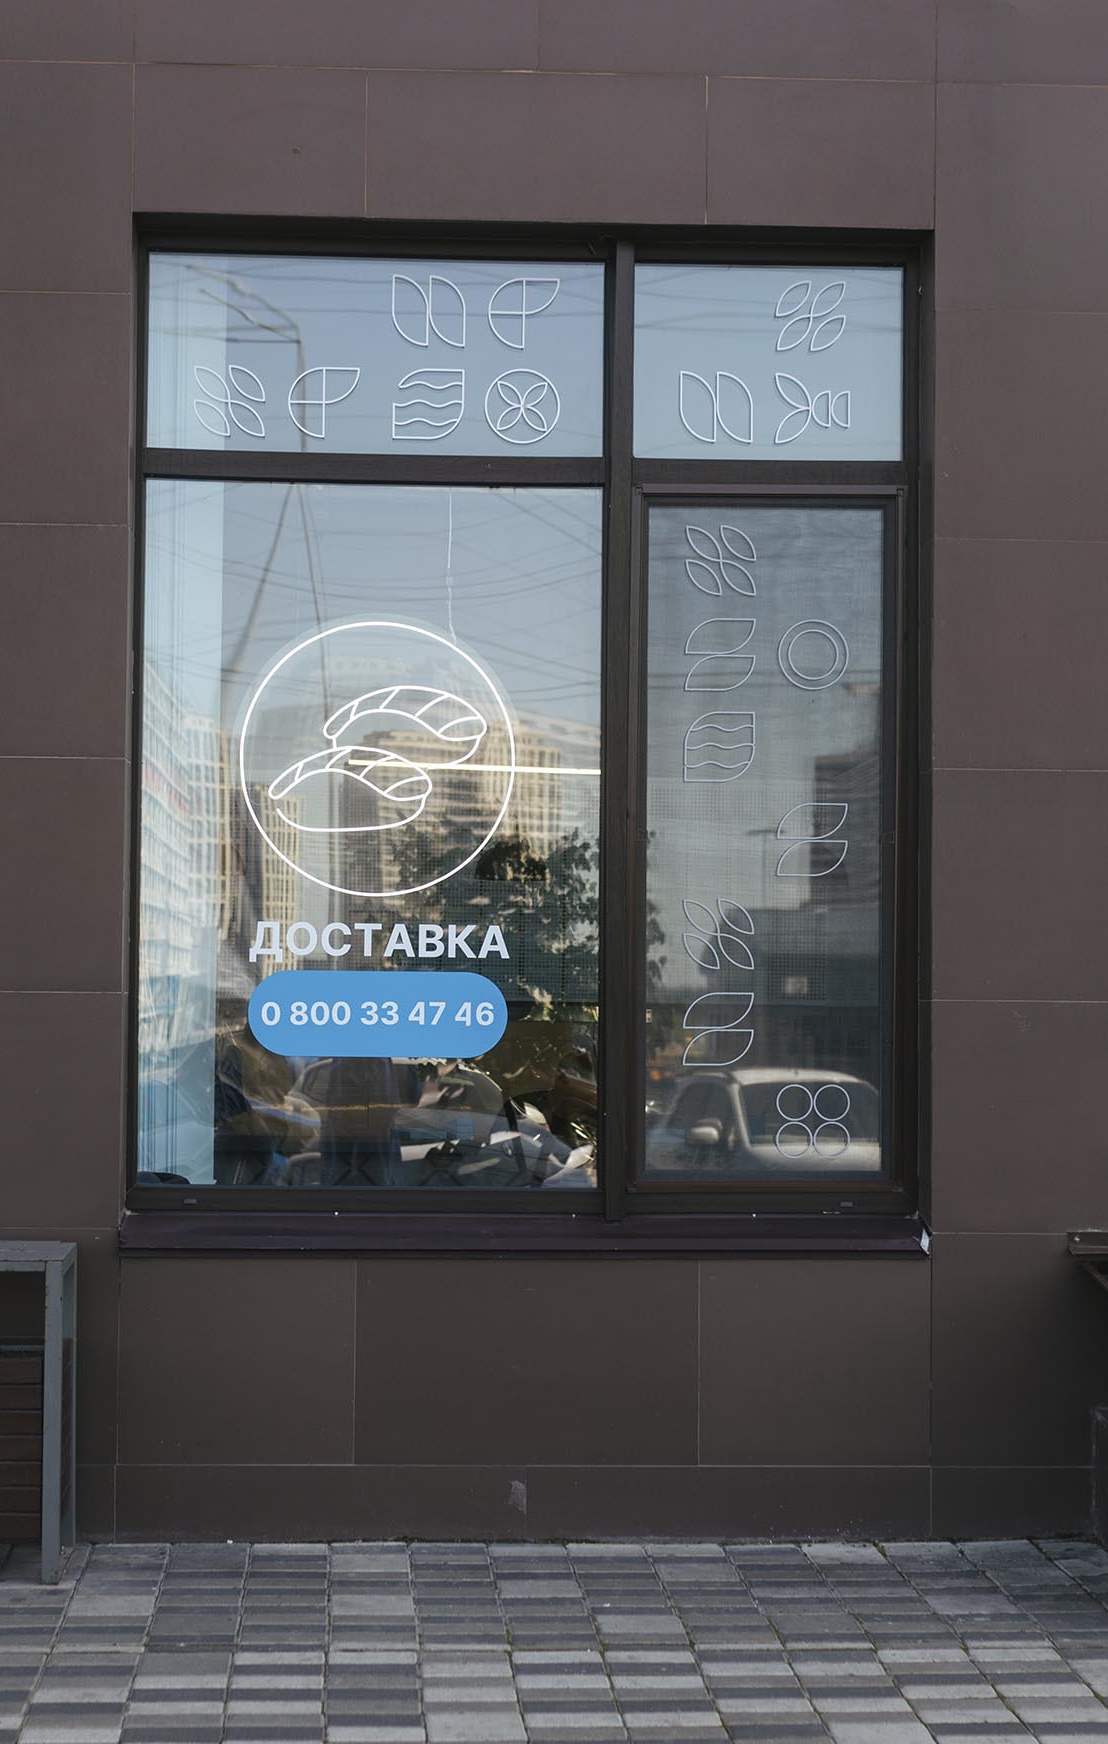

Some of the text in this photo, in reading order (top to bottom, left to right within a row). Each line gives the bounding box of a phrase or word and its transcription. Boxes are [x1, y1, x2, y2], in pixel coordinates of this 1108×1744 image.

[249, 921, 510, 963] ДОСТАВКА
[261, 1001, 495, 1027] 0 800 33 47 46
